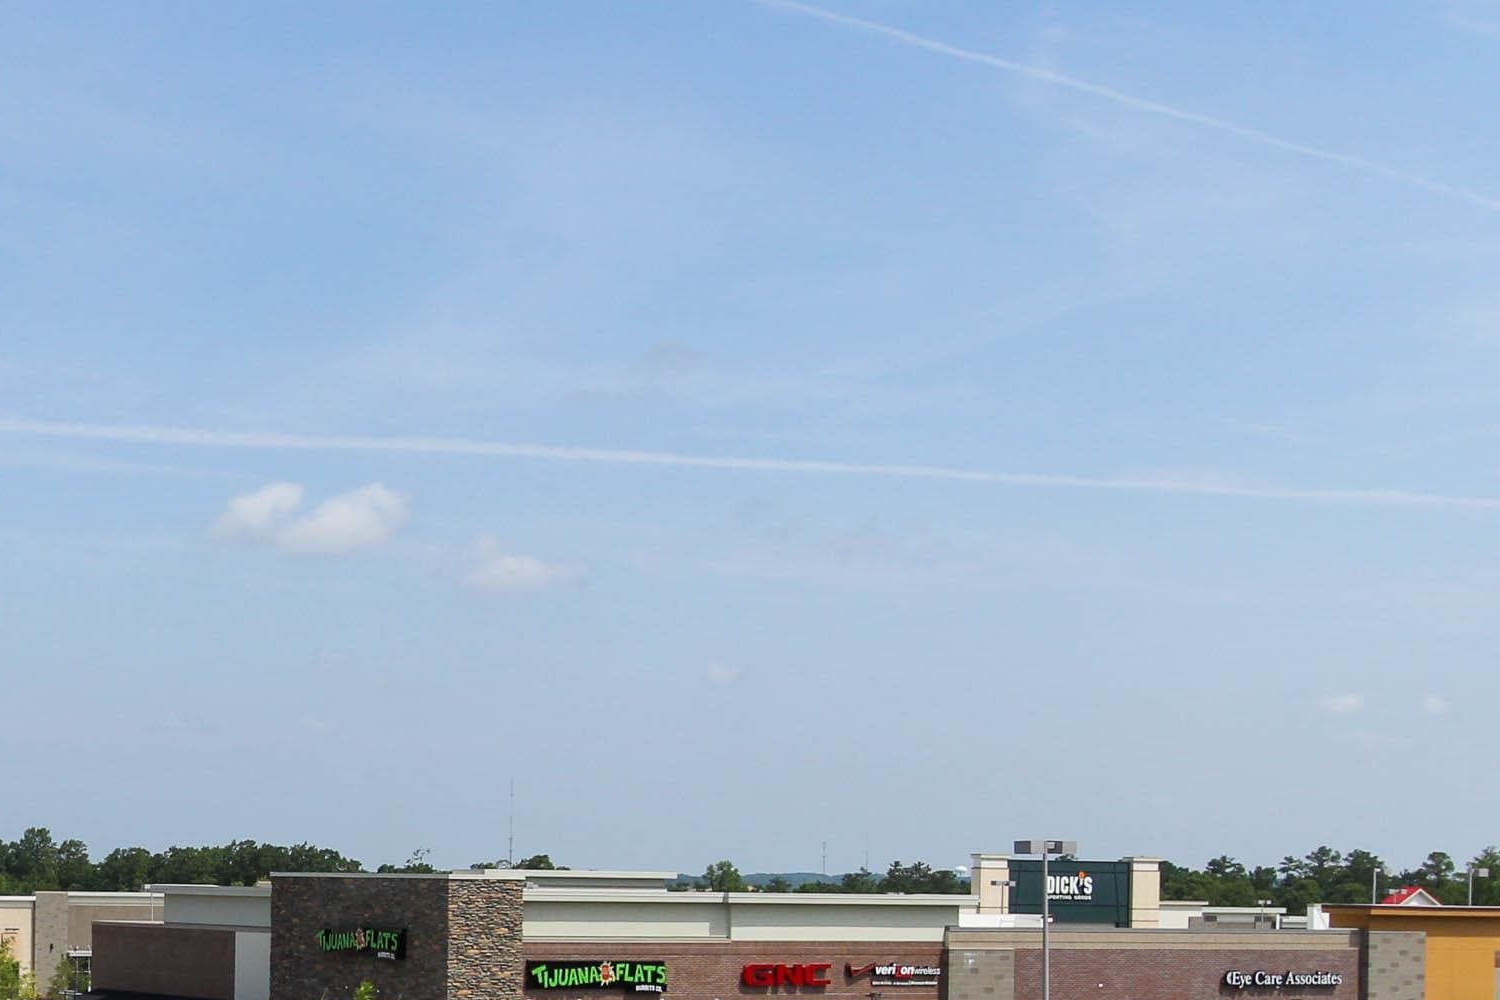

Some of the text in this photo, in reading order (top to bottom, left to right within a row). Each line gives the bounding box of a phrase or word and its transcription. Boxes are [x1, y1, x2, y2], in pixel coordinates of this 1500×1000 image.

[1047, 875, 1093, 895] DICK'S
[315, 928, 398, 951] TIJUANA FLATS
[531, 963, 667, 988] TIJUANA FLATS
[742, 963, 831, 988] GNC
[875, 963, 916, 978] verizon
[1232, 971, 1343, 989] Eye Care Associates
